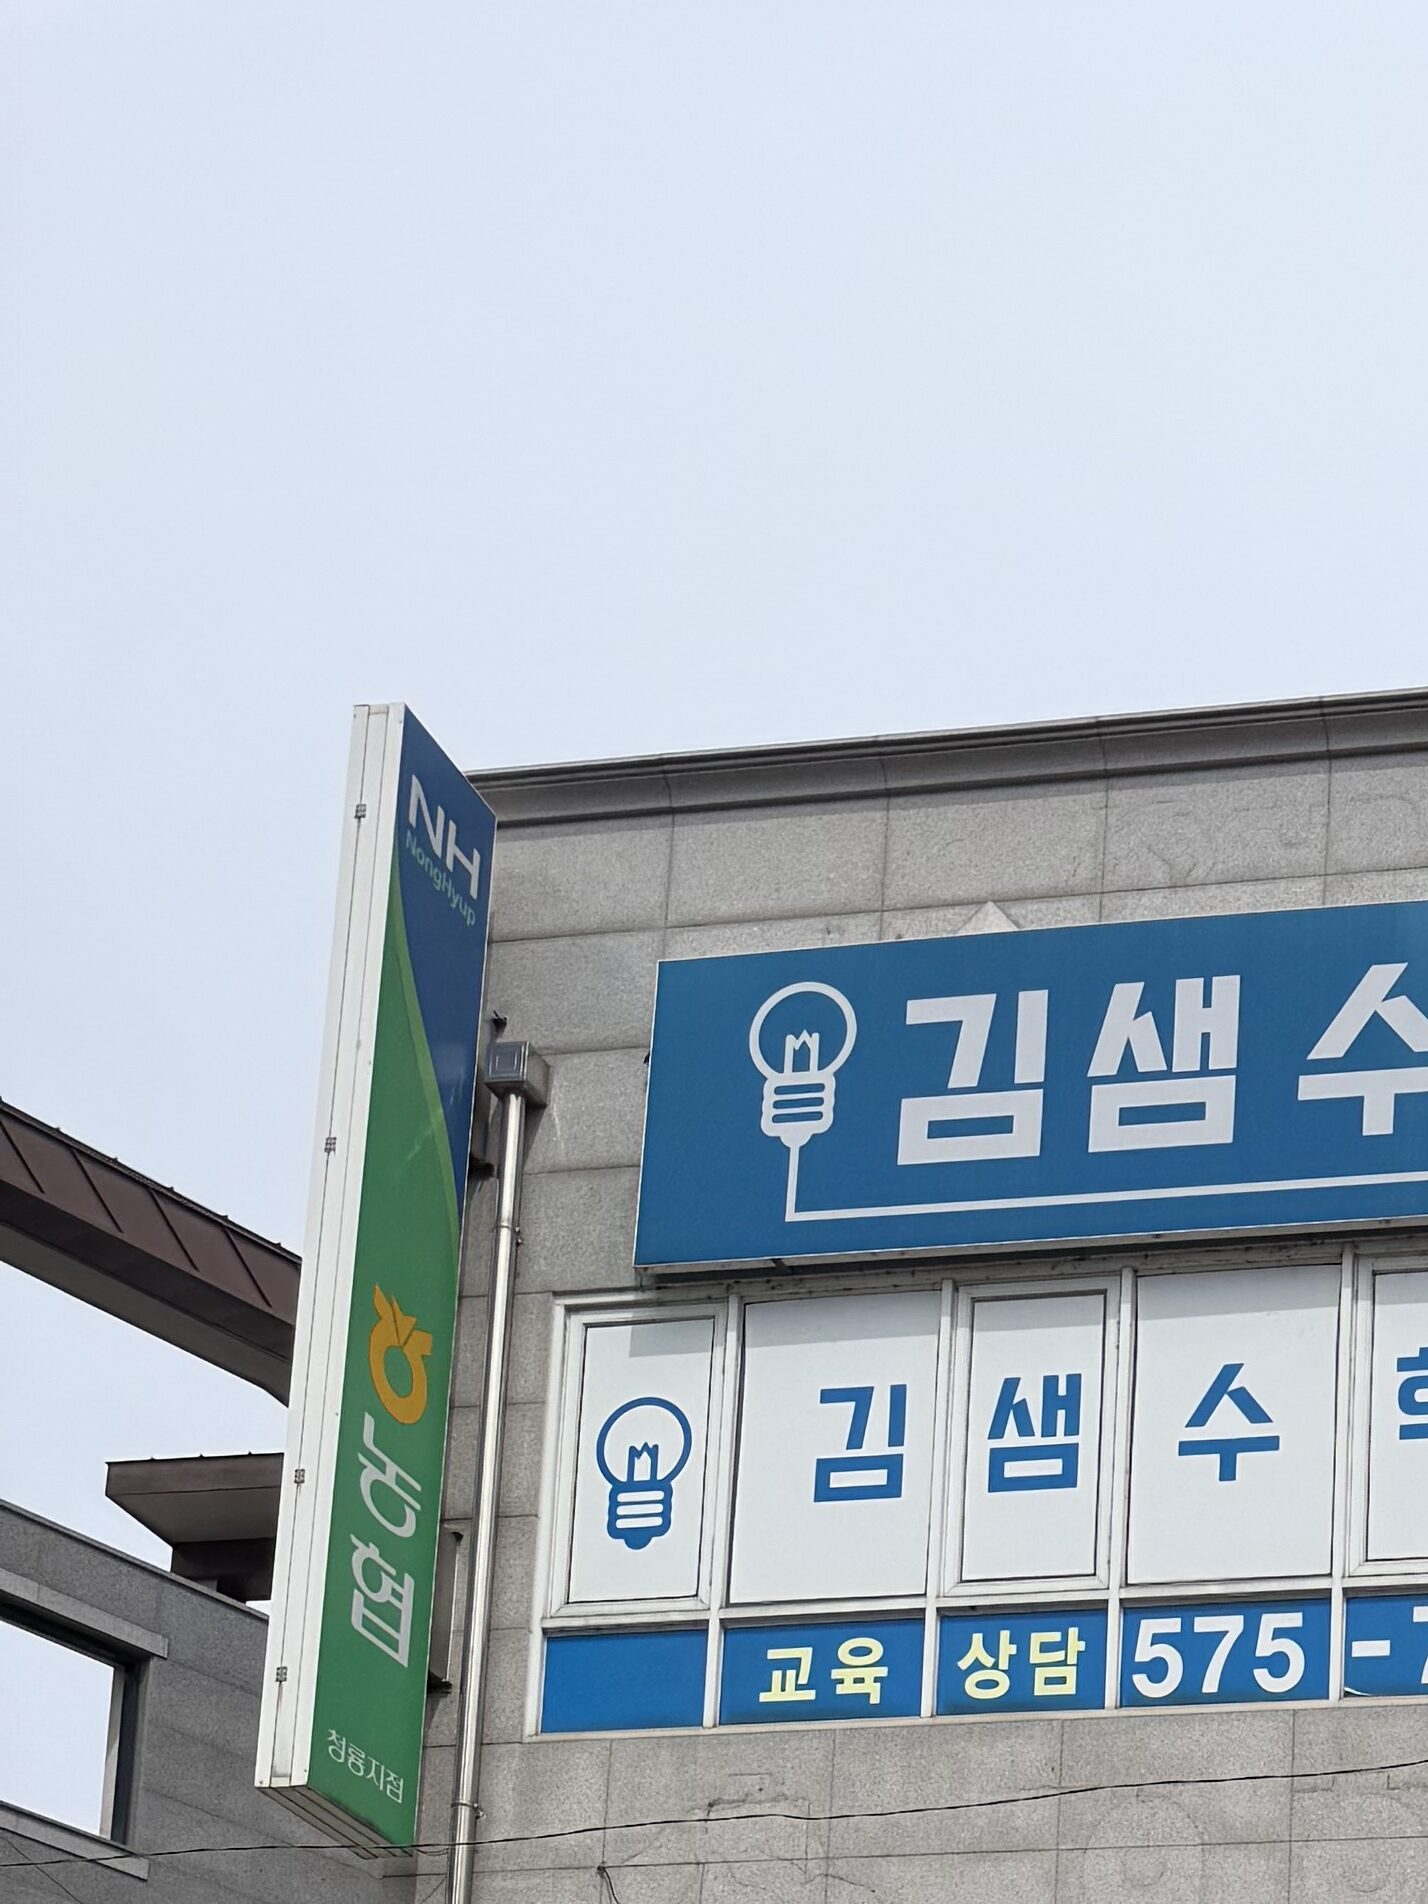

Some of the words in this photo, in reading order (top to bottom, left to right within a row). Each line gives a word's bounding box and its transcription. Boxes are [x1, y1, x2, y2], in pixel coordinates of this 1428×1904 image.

[406, 830, 476, 926] NongHyup
[409, 774, 480, 900] NH
[897, 975, 1241, 1165] 김샘
[350, 1413, 422, 1668] 농협
[760, 1638, 889, 1704] 교육
[957, 1628, 1086, 1699] 상담
[327, 1729, 404, 1804] 청룡지점
